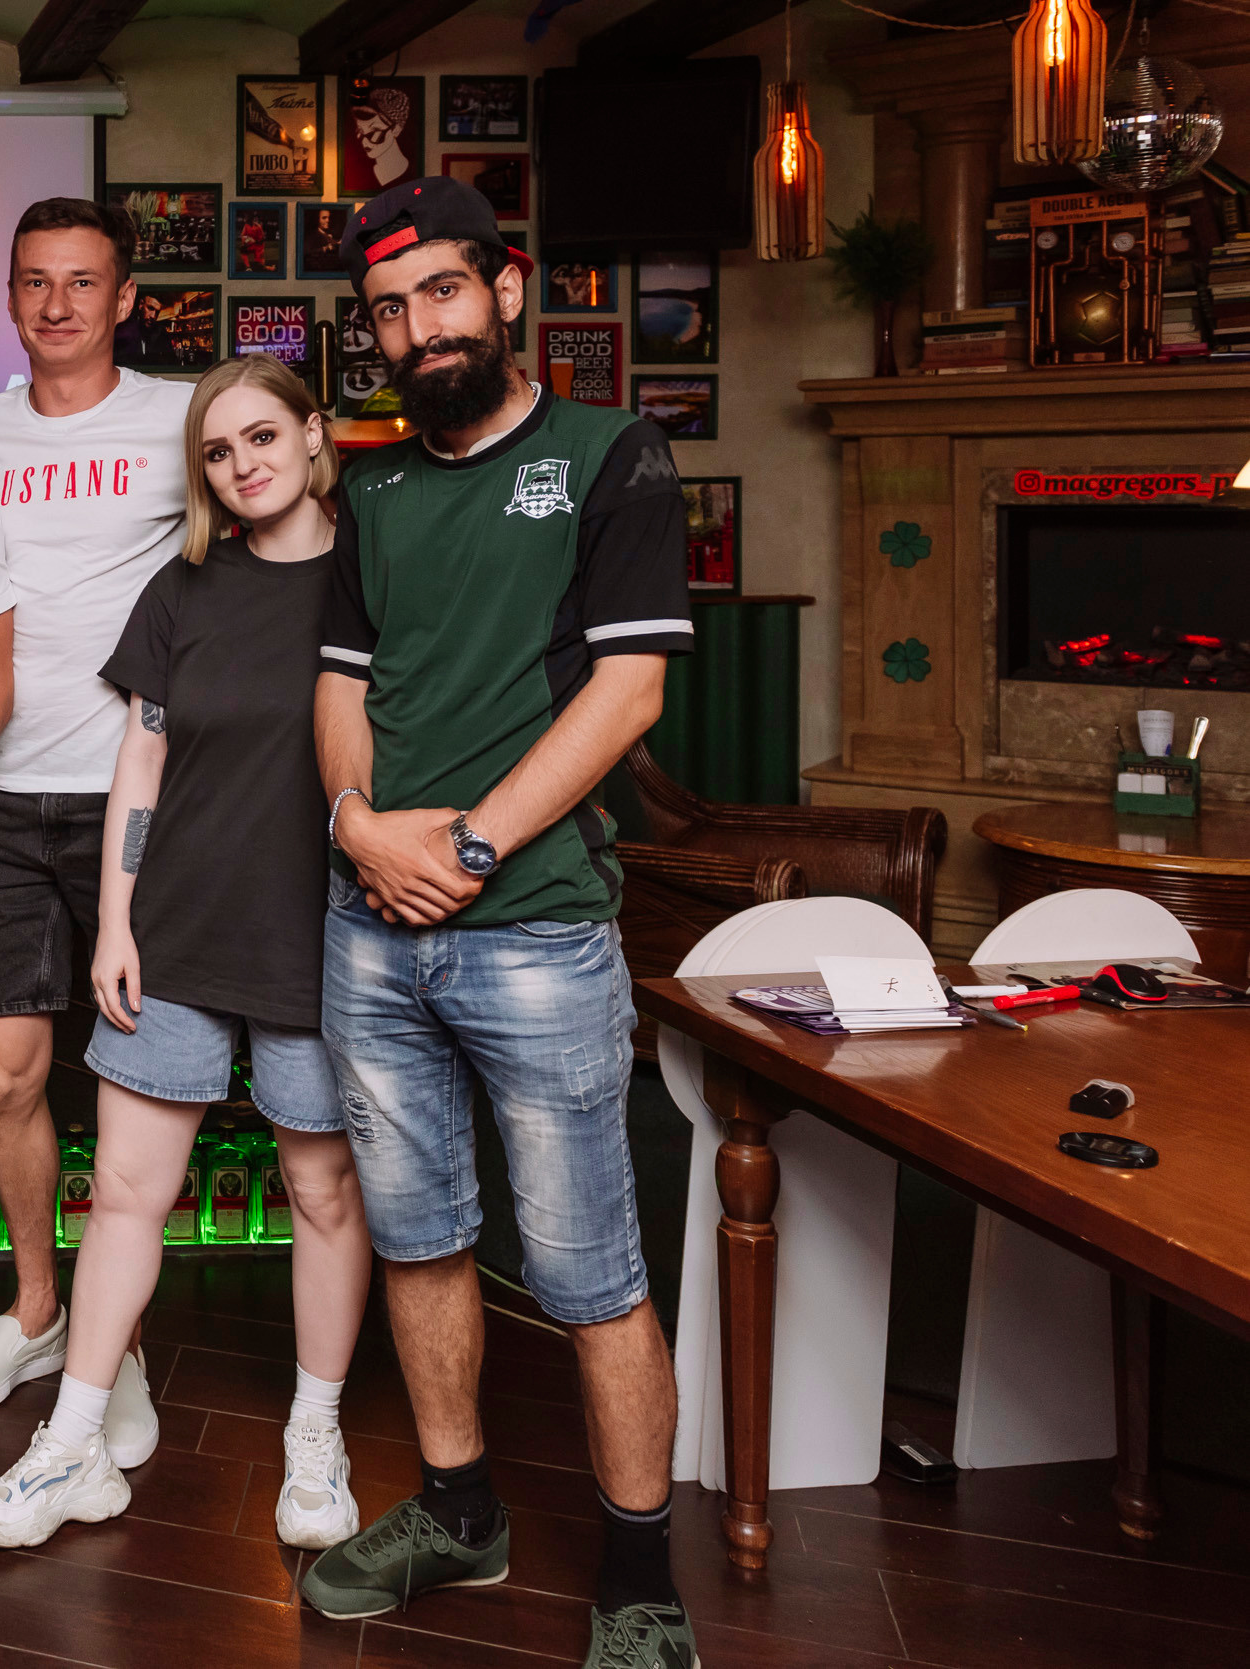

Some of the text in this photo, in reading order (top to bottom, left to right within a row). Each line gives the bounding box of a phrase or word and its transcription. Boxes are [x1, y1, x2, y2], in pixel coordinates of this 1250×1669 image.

[250, 154, 288, 171] ПИВО
[1042, 196, 1094, 213] DOUBLE
[238, 305, 305, 322] DRINK
[238, 324, 305, 343] GOOD
[548, 330, 611, 342] DRINK
[548, 343, 612, 356] GOOD
[575, 357, 612, 369] BEER
[573, 379, 612, 389] GOOD
[573, 389, 613, 400] FRIENDS
